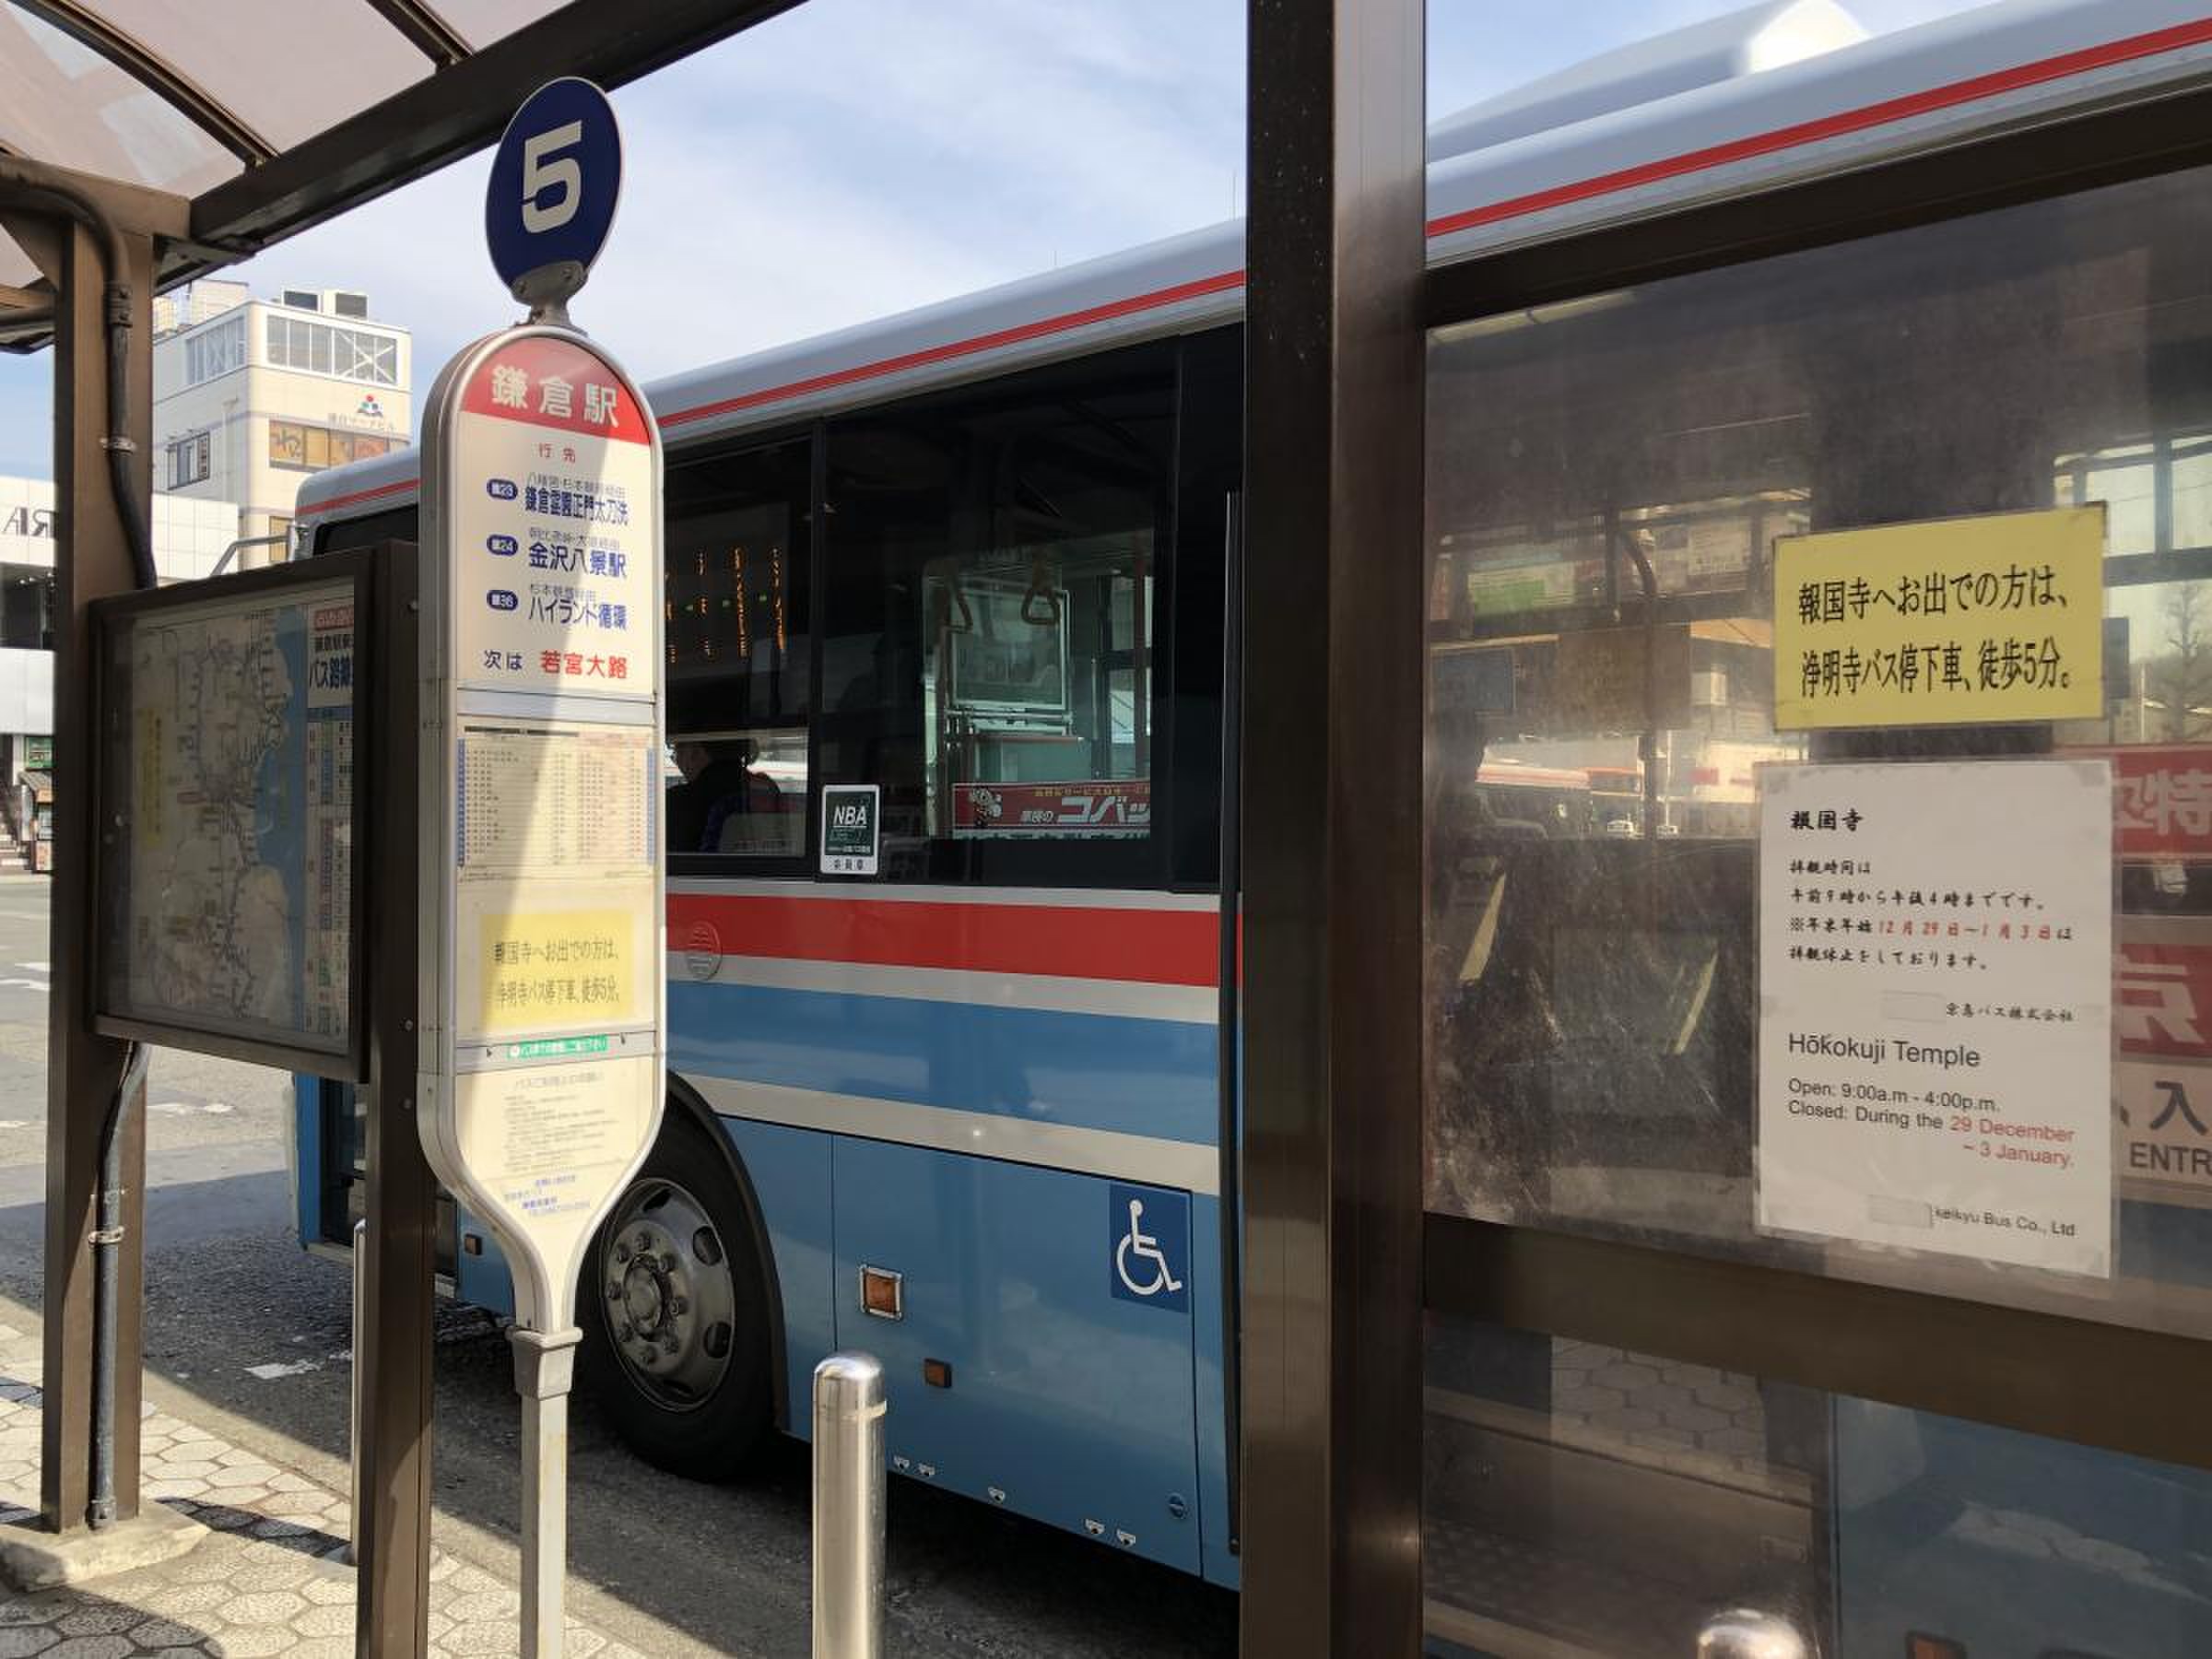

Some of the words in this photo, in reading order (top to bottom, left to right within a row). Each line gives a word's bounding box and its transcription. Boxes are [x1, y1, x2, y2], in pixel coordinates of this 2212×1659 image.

[522, 120, 582, 233] 5
[491, 365, 619, 428] 鎌倉駅
[529, 542, 628, 578] 金沢八景駅
[1799, 564, 2068, 624] 報国寺へお出での方は、
[529, 596, 628, 630] ハイランド循環
[484, 650, 524, 672] 次は
[540, 649, 627, 679] 若宮大路
[1801, 636, 2070, 699] 浄明寺バス停下車、徒歩5分。
[833, 806, 867, 826] NBA
[1790, 807, 1865, 832] 報国寺
[1789, 858, 1871, 877] 拝観時間は
[1892, 1039, 1981, 1069] Temple
[1788, 1077, 1836, 1098] Open:
[1924, 1090, 2001, 1112] 4:00p.m.
[1788, 1099, 1848, 1120] Closed:
[1855, 1105, 1909, 1129] During
[1916, 1112, 1944, 1130] the
[1950, 1115, 1972, 1133] 29
[1979, 1118, 2076, 1143] December
[1979, 1141, 1991, 1158] 3
[1995, 1144, 2075, 1170] January.
[1983, 1211, 2012, 1228] Bus
[2051, 1219, 2076, 1236] Ltd
